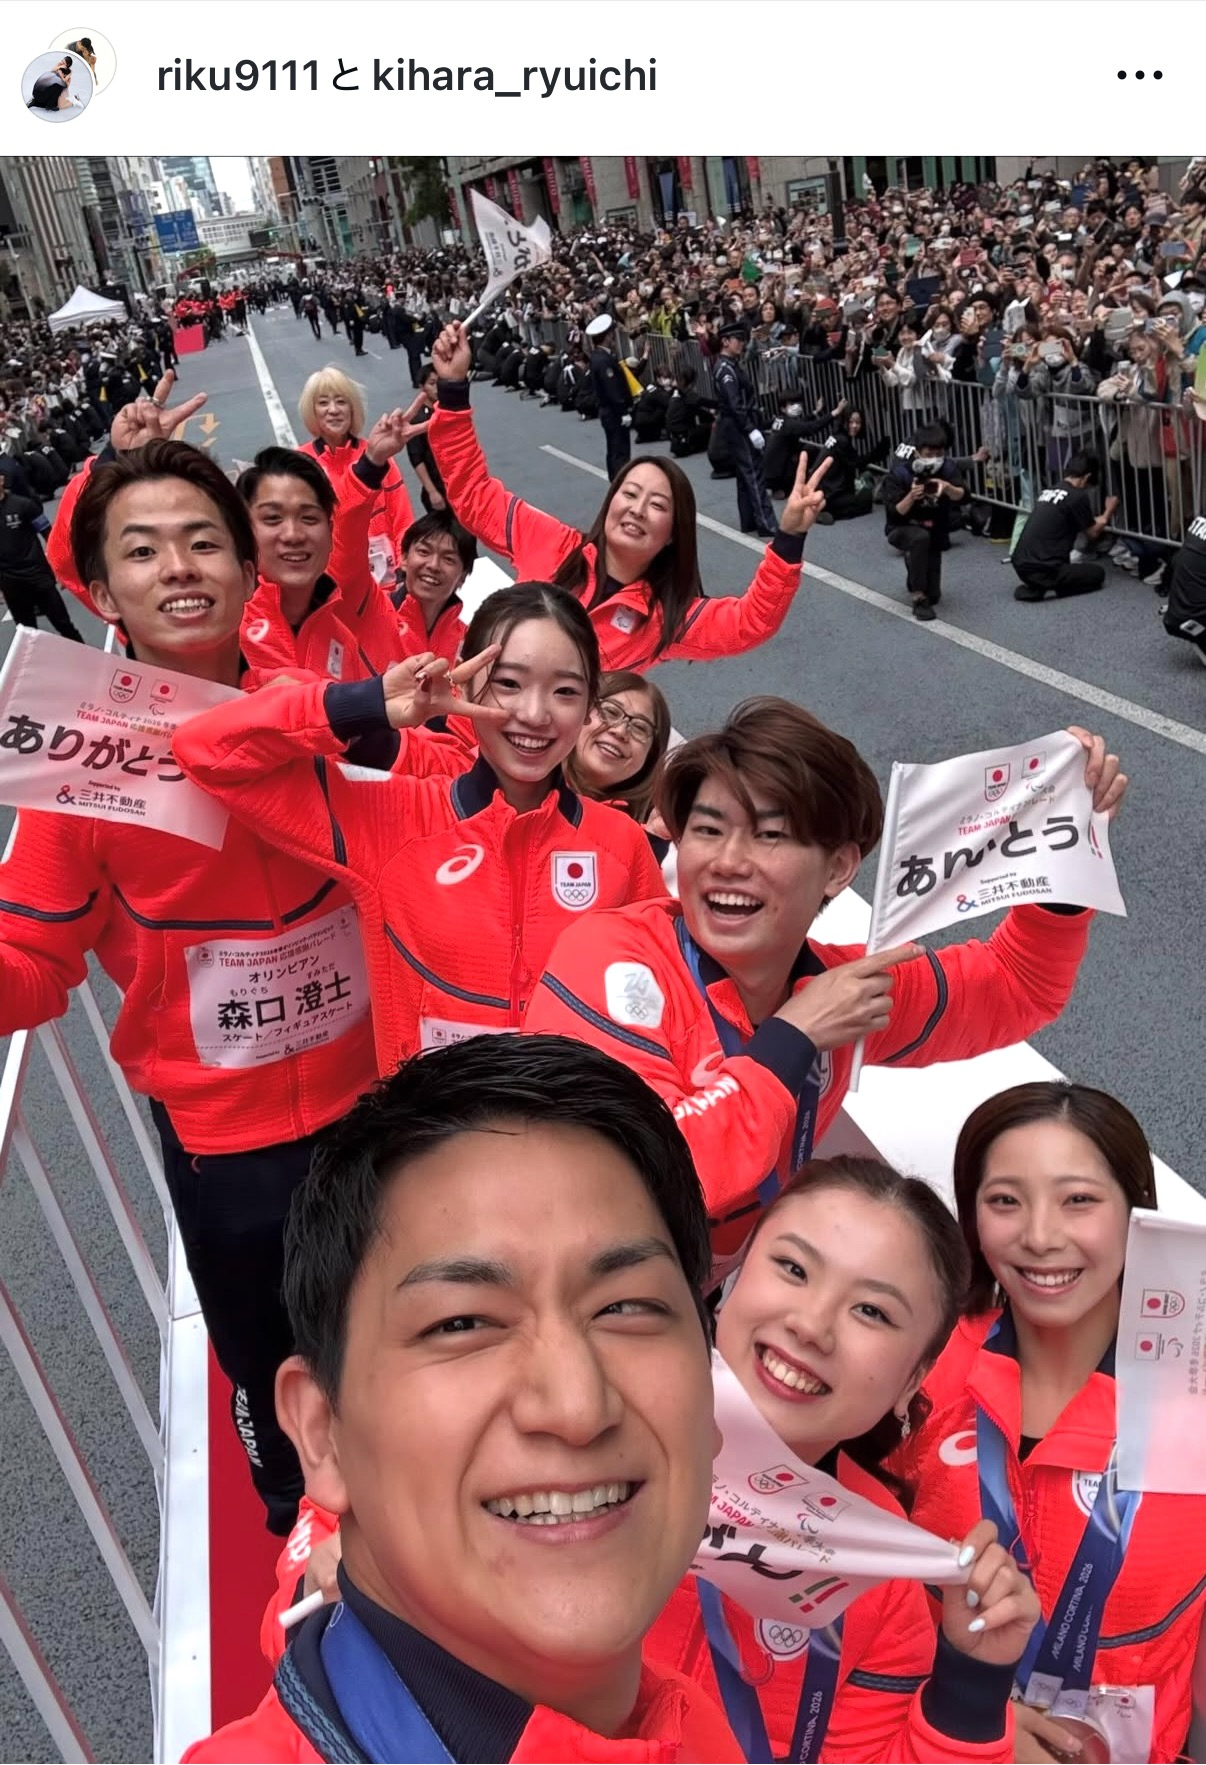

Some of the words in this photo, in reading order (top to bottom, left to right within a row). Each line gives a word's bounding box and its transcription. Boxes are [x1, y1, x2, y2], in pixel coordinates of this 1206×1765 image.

[76, 710, 99, 722] TEAM
[101, 716, 128, 728] JAPAN
[79, 788, 147, 810] 三井不動産
[958, 823, 982, 836] TEAM
[978, 876, 1050, 899] 三井不動産
[219, 957, 245, 967] TEAM
[246, 956, 278, 966] JAPAN
[249, 955, 319, 983] オリンピアン
[218, 995, 285, 1030] 森口
[295, 971, 351, 1016] 澄士
[1051, 1622, 1070, 1660] MILANO
[1064, 1585, 1086, 1622] CORTINA
[1079, 1563, 1093, 1584] 2026
[1073, 1634, 1088, 1672] MILANO
[800, 1715, 818, 1760] CORTINA
[810, 1691, 823, 1714] 2026
